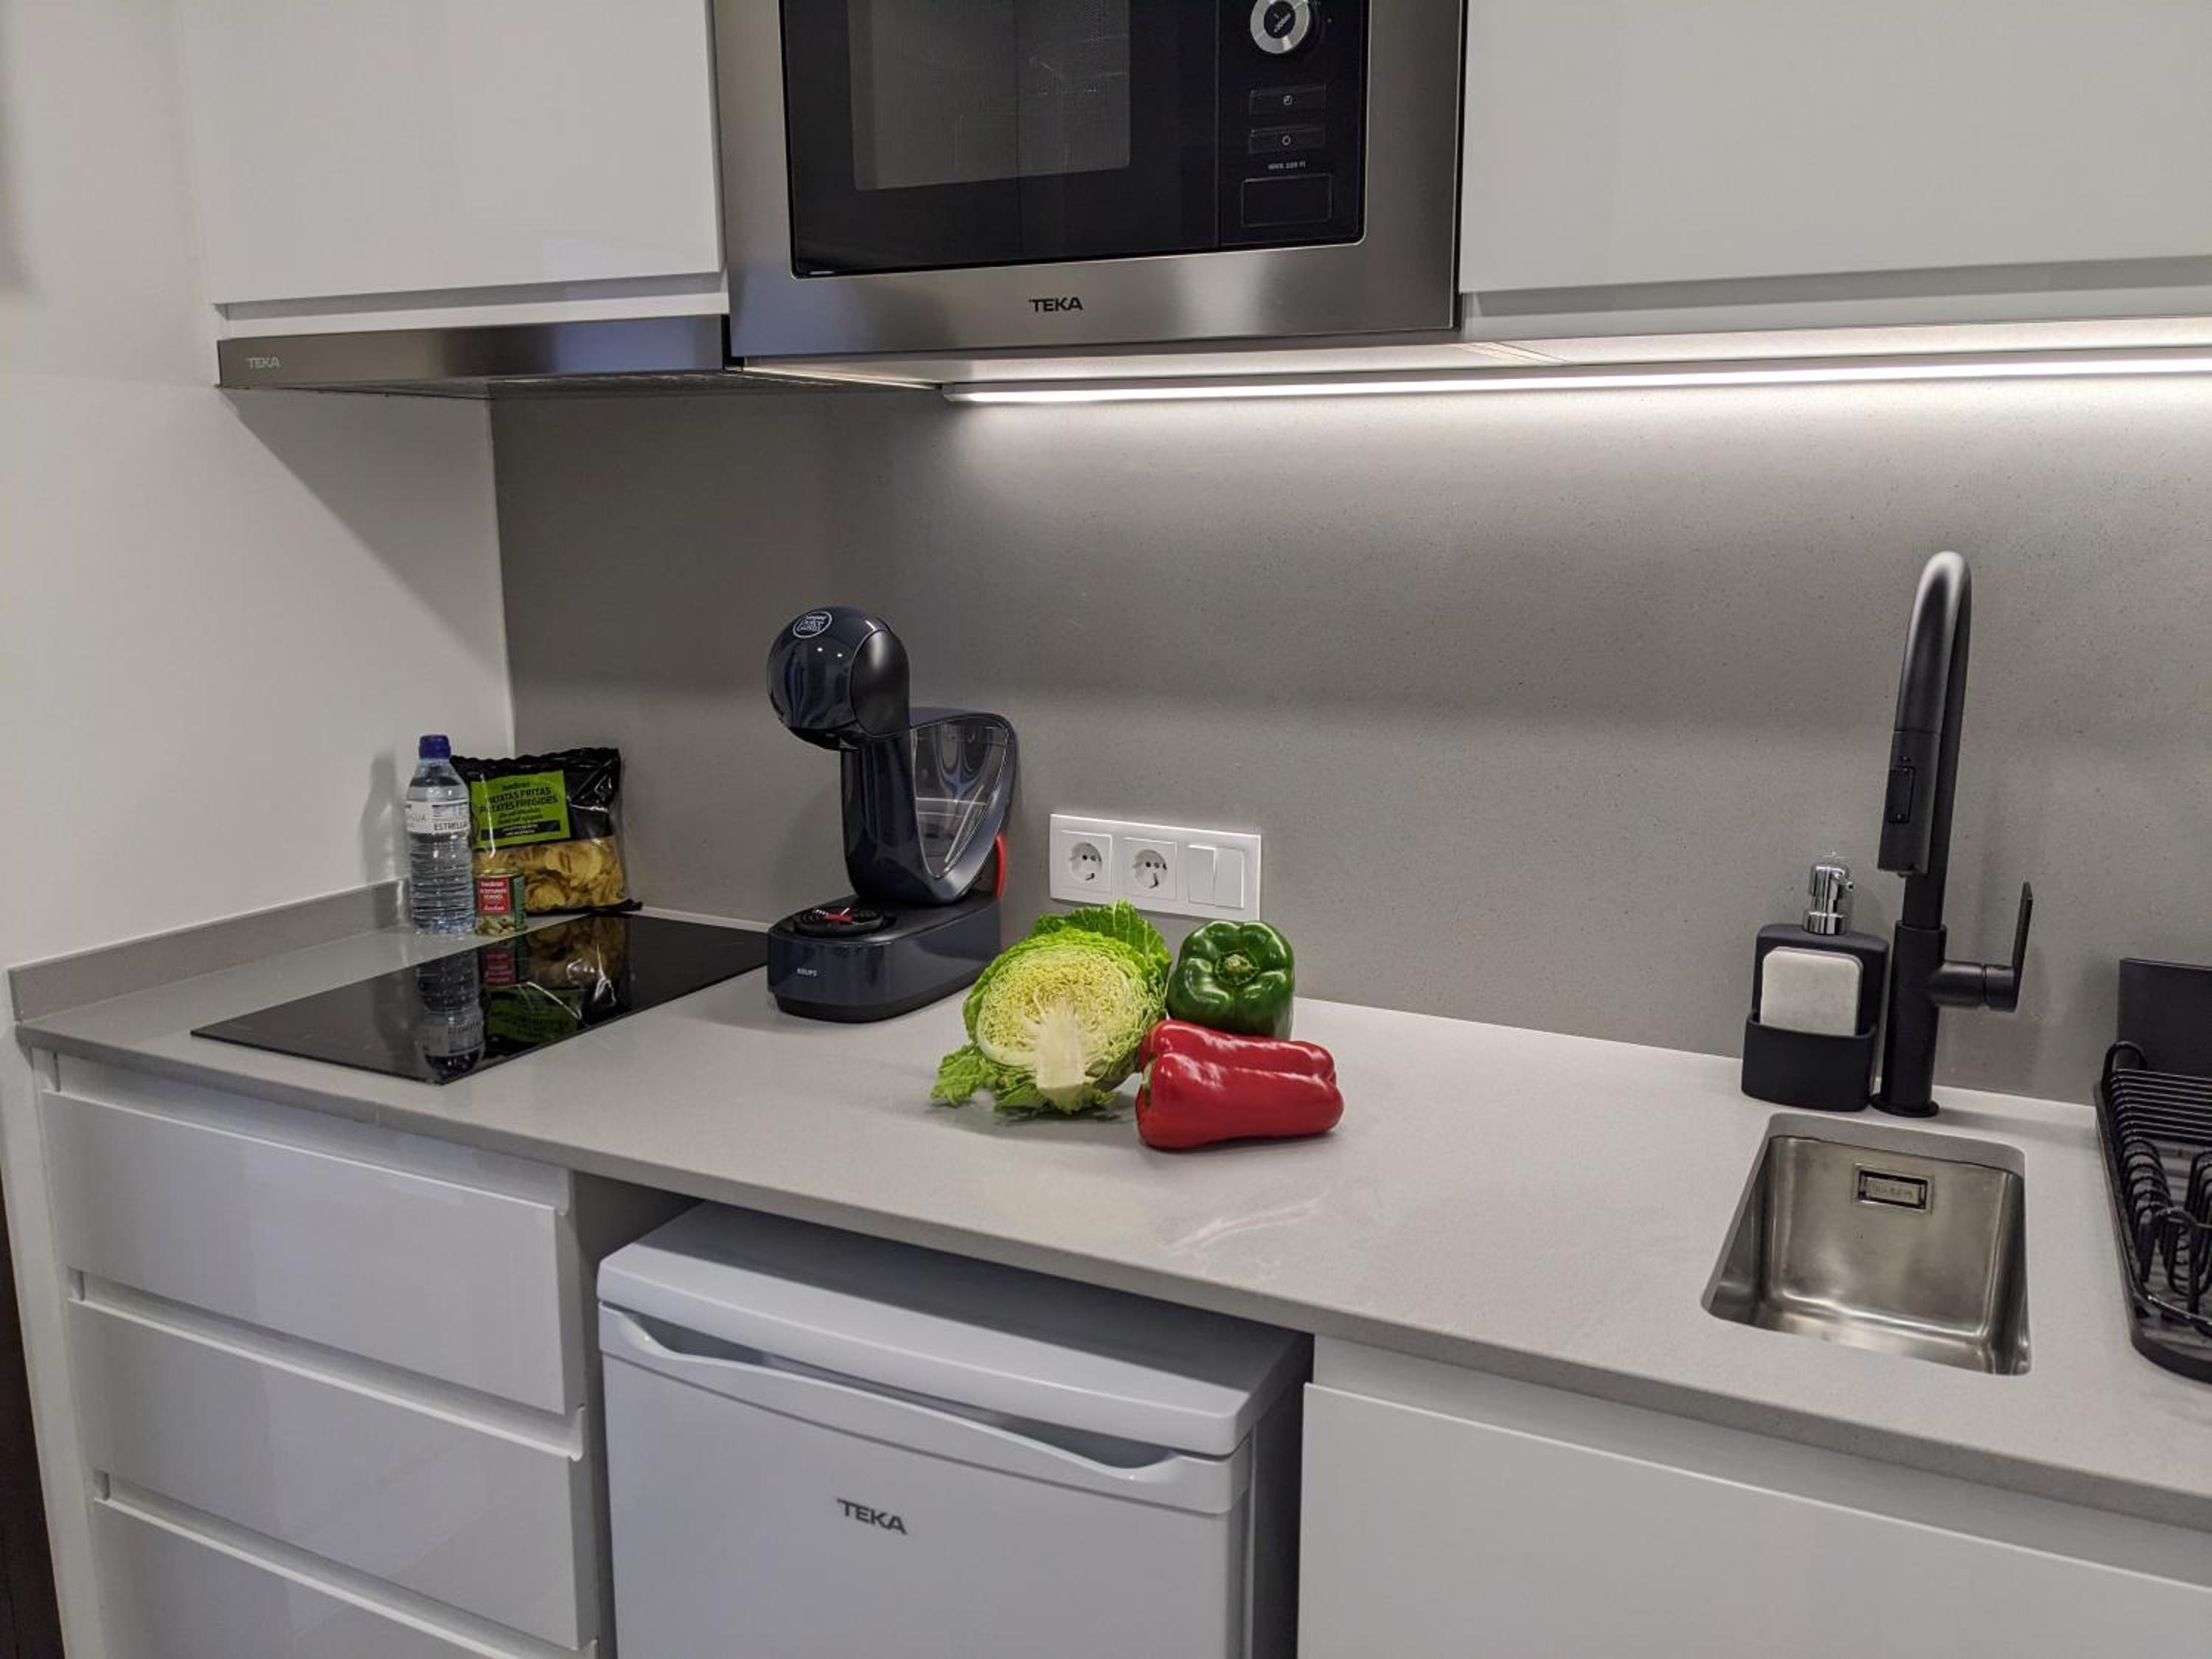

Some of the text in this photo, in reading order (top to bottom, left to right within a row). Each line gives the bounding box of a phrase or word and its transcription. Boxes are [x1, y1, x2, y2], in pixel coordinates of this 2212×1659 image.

[1029, 296, 1083, 313] TEKA
[246, 357, 281, 369] TEKA
[484, 790, 520, 804] ATATAS
[837, 1498, 907, 1535] TEKA
